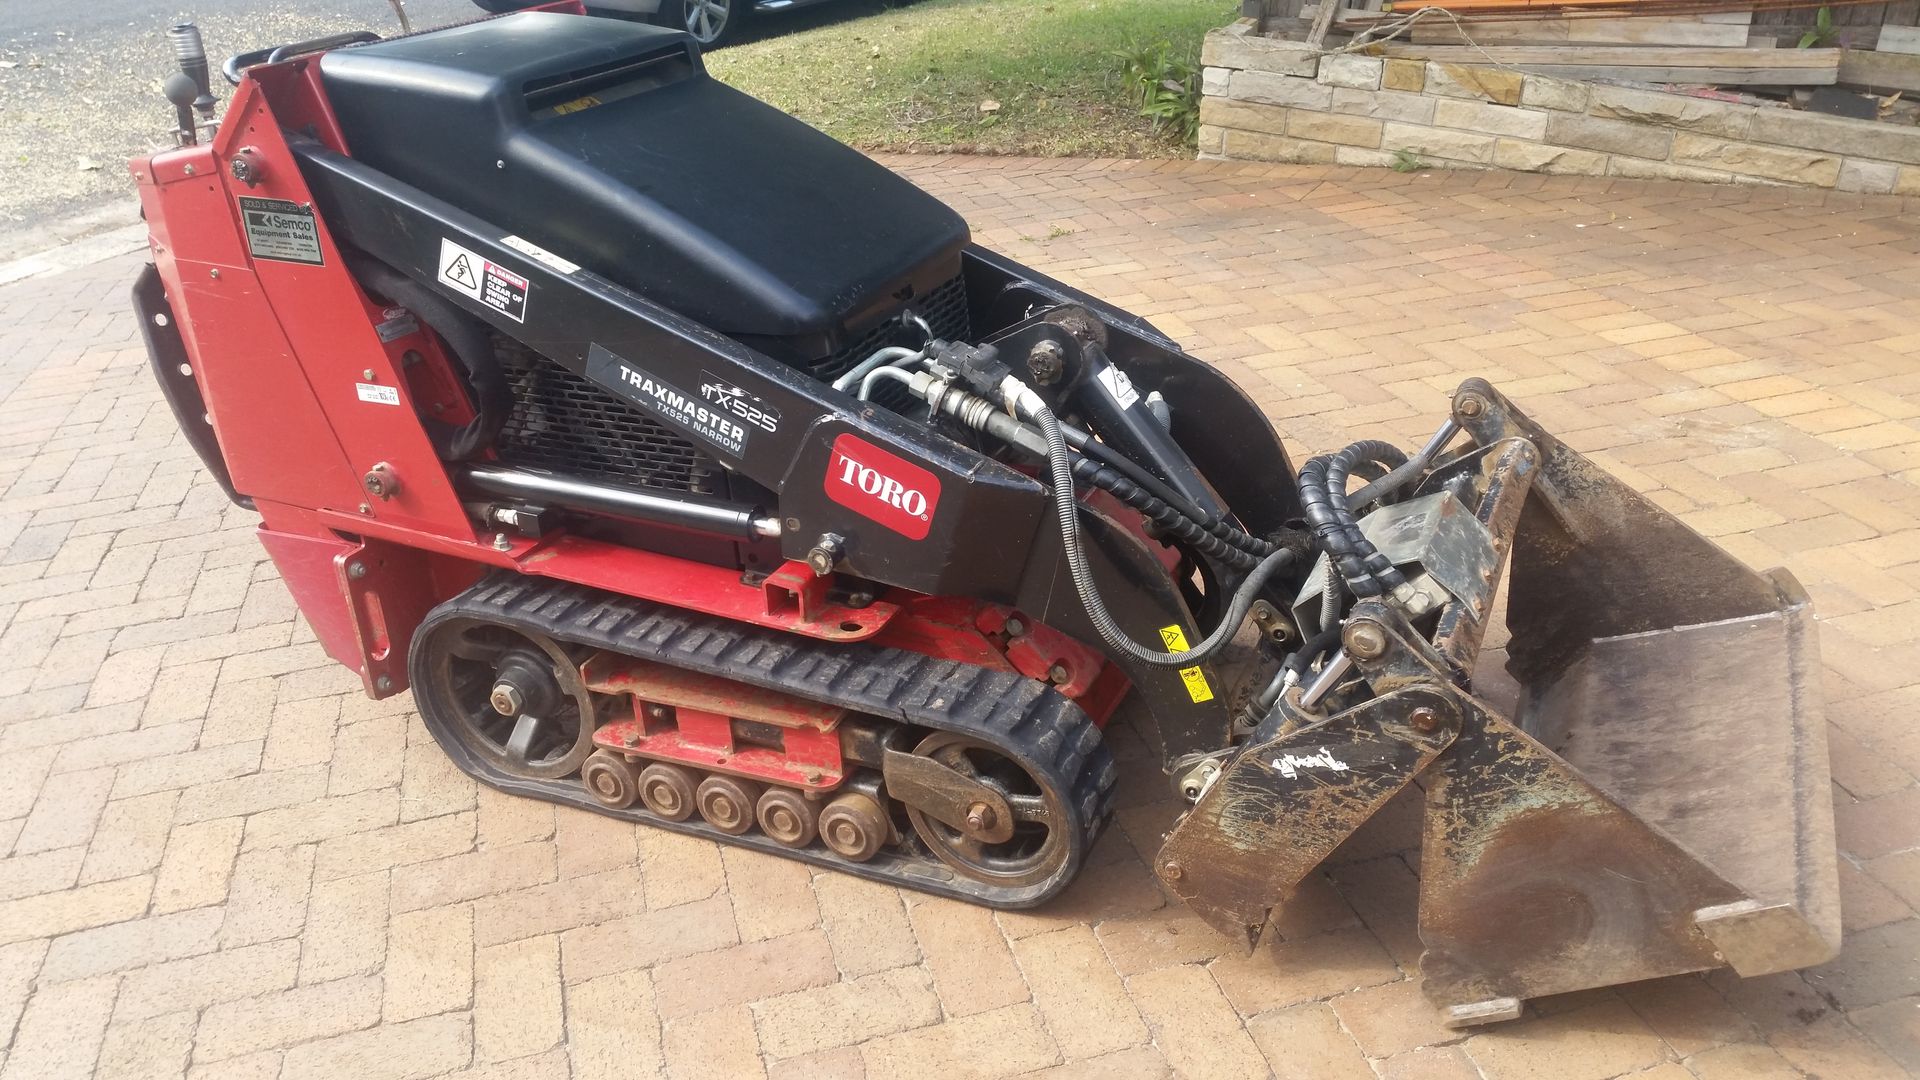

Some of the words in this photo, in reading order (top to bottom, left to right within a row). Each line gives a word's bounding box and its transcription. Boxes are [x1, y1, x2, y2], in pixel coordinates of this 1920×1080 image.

[244, 200, 260, 209] SOLD
[268, 202, 298, 212] SERVICED
[273, 215, 311, 232] Semco
[251, 227, 291, 239] Equipment
[293, 231, 314, 241] Sales
[487, 273, 508, 288] KEEP
[496, 269, 523, 288] DANGER
[485, 287, 510, 305] SWING
[487, 281, 511, 298] CLEAR
[512, 293, 524, 303] OF
[484, 295, 505, 310] AREA
[619, 365, 745, 443] TRAXMASTER
[656, 401, 689, 425] TX525
[692, 420, 742, 452] NARROW
[838, 454, 928, 518] TORO
